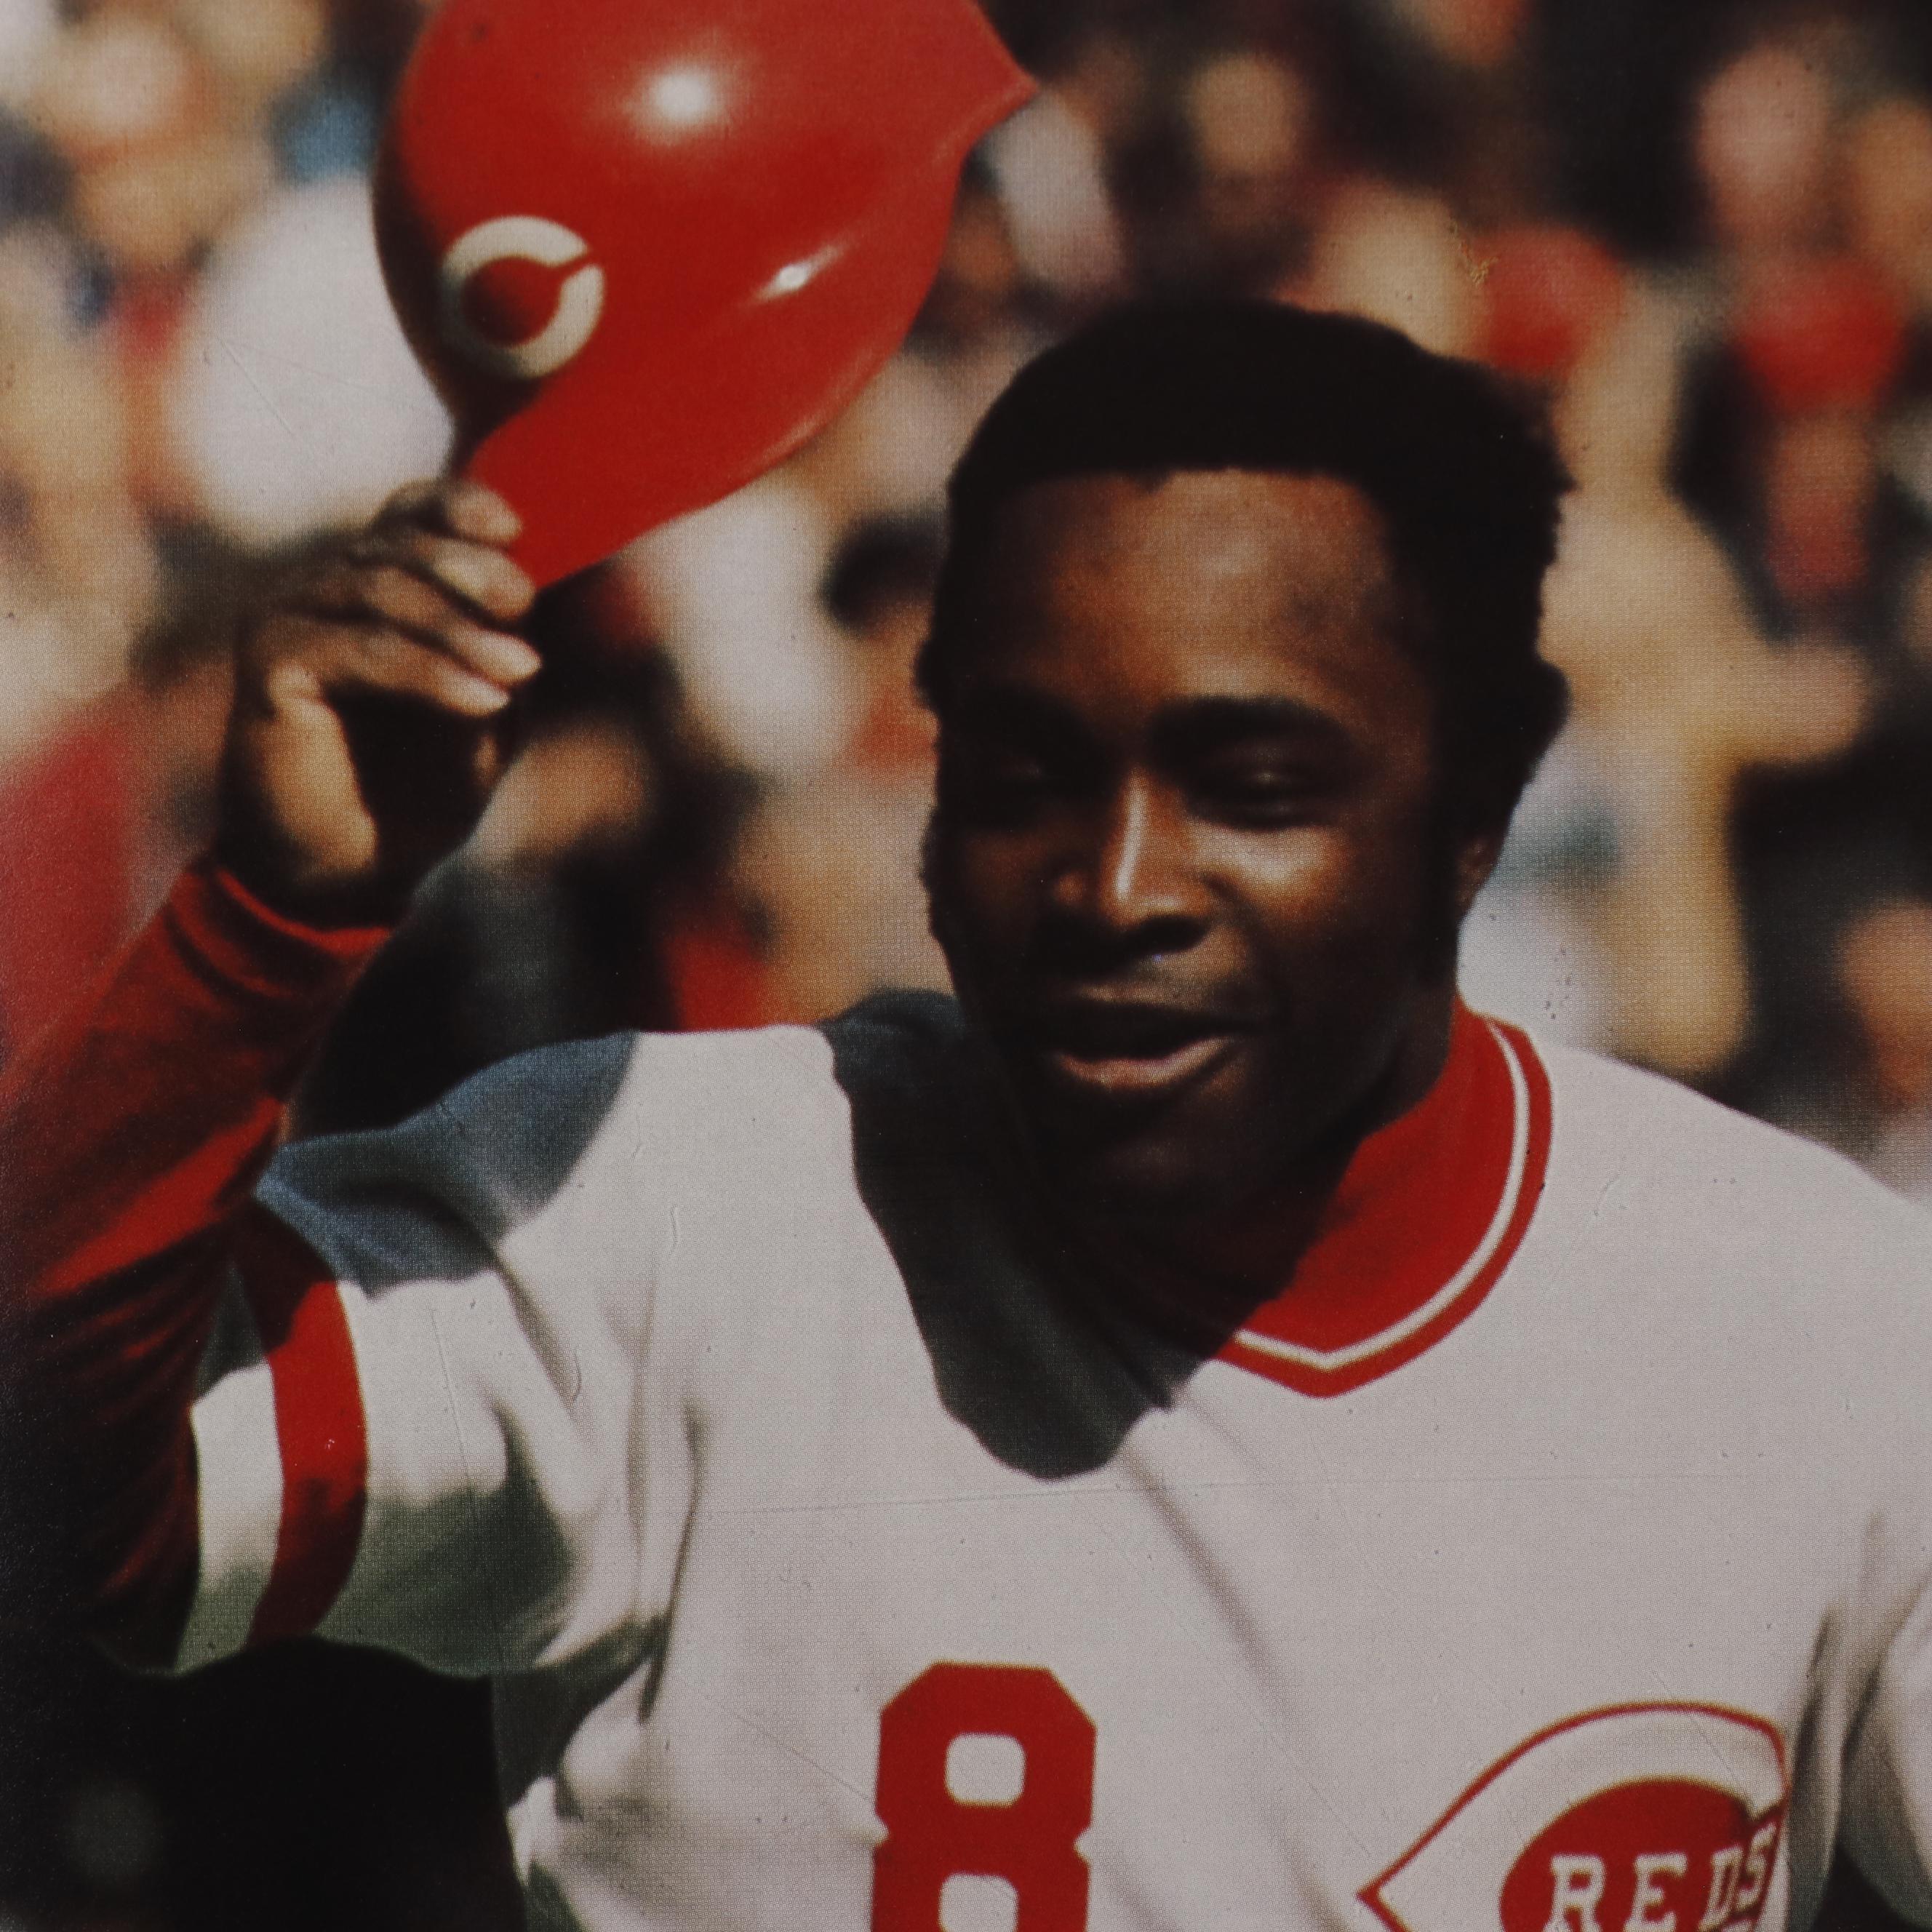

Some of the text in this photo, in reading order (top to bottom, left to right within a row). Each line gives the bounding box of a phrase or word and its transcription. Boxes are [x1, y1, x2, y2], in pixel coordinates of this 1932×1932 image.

[439, 216, 605, 380] C
[871, 1659, 1097, 1932] 8
[1542, 1821, 1776, 1932] REDS
